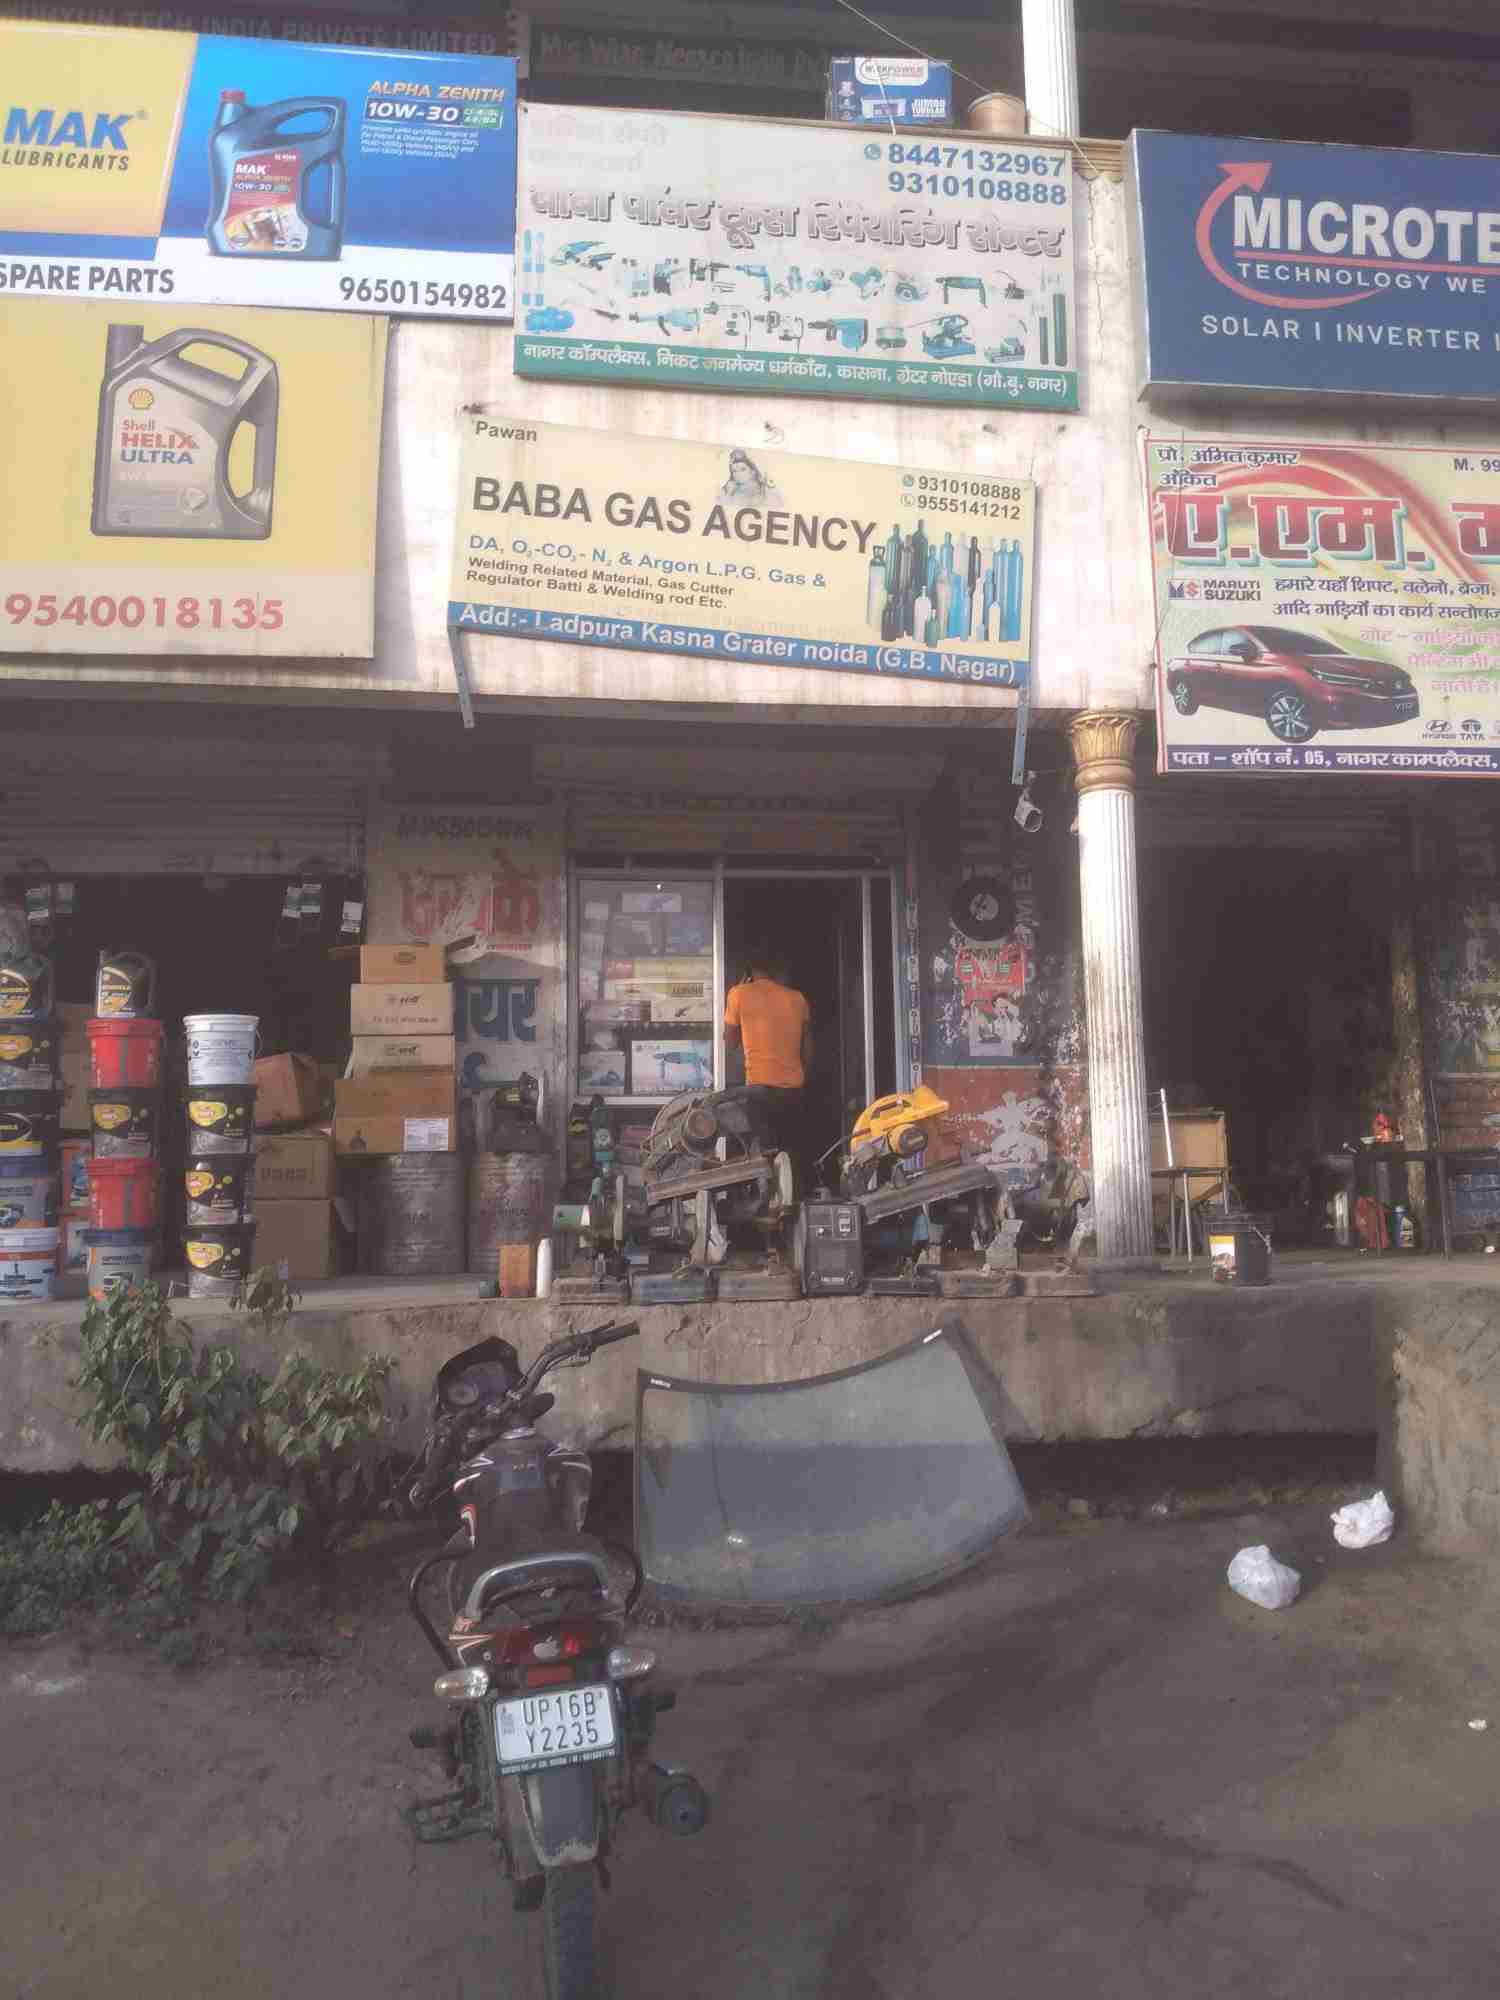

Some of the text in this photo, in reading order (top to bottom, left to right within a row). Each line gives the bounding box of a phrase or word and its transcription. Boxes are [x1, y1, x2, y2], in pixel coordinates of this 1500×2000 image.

[368, 80, 505, 102] ALPHA ZENITH
[367, 102, 459, 122] 10W-30
[3, 107, 128, 151] MAK
[2, 149, 129, 172] LUBRICANTS
[236, 164, 267, 175] MAK
[888, 142, 1066, 178] 8447132967
[888, 170, 1068, 206] 9310108888
[1233, 195, 1500, 264] MICROTE
[0, 262, 175, 294] SPARE PARTS
[339, 275, 507, 309] 9650154982
[1237, 262, 1487, 294] TECHNOLOGY WE
[1201, 315, 1299, 340] SOLAR
[1336, 322, 1481, 351] INVERTER
[523, 343, 566, 361] नागर
[656, 347, 699, 369] निकट
[931, 365, 973, 388] नोएडा
[121, 418, 155, 431] Shell
[475, 420, 538, 442] Pawan
[120, 432, 196, 449] HELIX
[120, 450, 195, 465] ULTRA
[1190, 446, 1243, 462] अमित
[1245, 450, 1299, 470] कुमार
[1453, 456, 1476, 472] M.
[918, 474, 1021, 502] 9310108888
[472, 476, 877, 554] BABA GAS AGENCY
[917, 494, 1021, 520] 9555141212
[468, 556, 529, 574] Welding
[533, 562, 588, 579] Related
[658, 577, 686, 591] Gas
[690, 582, 735, 597] Cutter
[618, 551, 633, 566] &
[638, 554, 699, 575] Argon
[706, 562, 761, 581] L.P.G.
[768, 568, 806, 586] Gas
[812, 574, 826, 588] &
[466, 570, 728, 609] Regulator Batti & Welding rod Etc.
[1203, 579, 1261, 590] MARUTI
[1204, 590, 1262, 601] SUZUKI
[1274, 577, 1314, 593] हमारे
[4, 593, 285, 631] 9540018135
[1271, 599, 1311, 616] आदि
[1373, 603, 1395, 617] का
[1399, 602, 1434, 618] कार्य
[460, 605, 528, 627] Add:-
[641, 622, 716, 649] Kasna
[723, 631, 798, 657] Grater
[803, 642, 868, 665] noida
[874, 647, 932, 671] (G.B.
[940, 655, 1016, 685] Nagar)
[1460, 733, 1486, 741] TATA
[1172, 750, 1210, 765] पता
[1336, 751, 1389, 767] नागर
[523, 1691, 596, 1726] UP16B
[526, 1719, 599, 1753] Y2235
